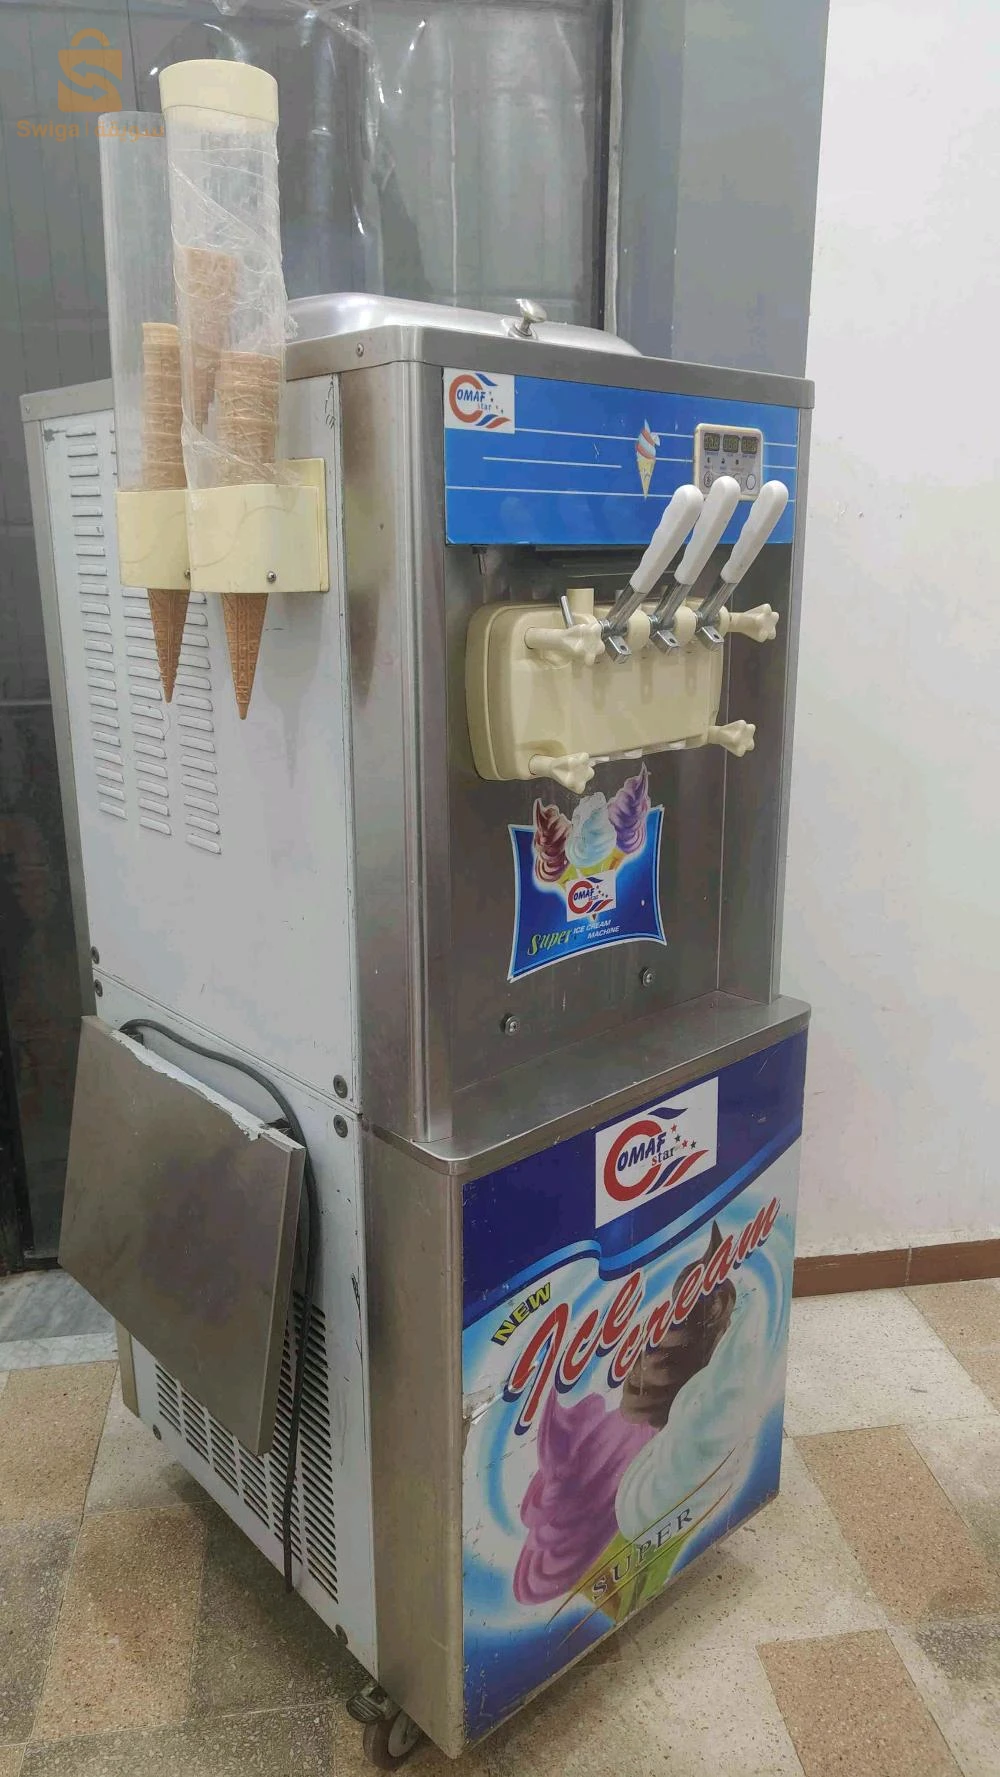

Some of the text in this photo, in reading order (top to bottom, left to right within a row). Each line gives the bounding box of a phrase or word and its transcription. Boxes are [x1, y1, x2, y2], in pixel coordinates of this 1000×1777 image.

[527, 919, 612, 955] Super ICE CREAM
[587, 925, 620, 939] MACHINE
[651, 1146, 675, 1167] star
[491, 1282, 551, 1346] NEW
[505, 1271, 644, 1431] Ice
[592, 1508, 692, 1601] SUPER
